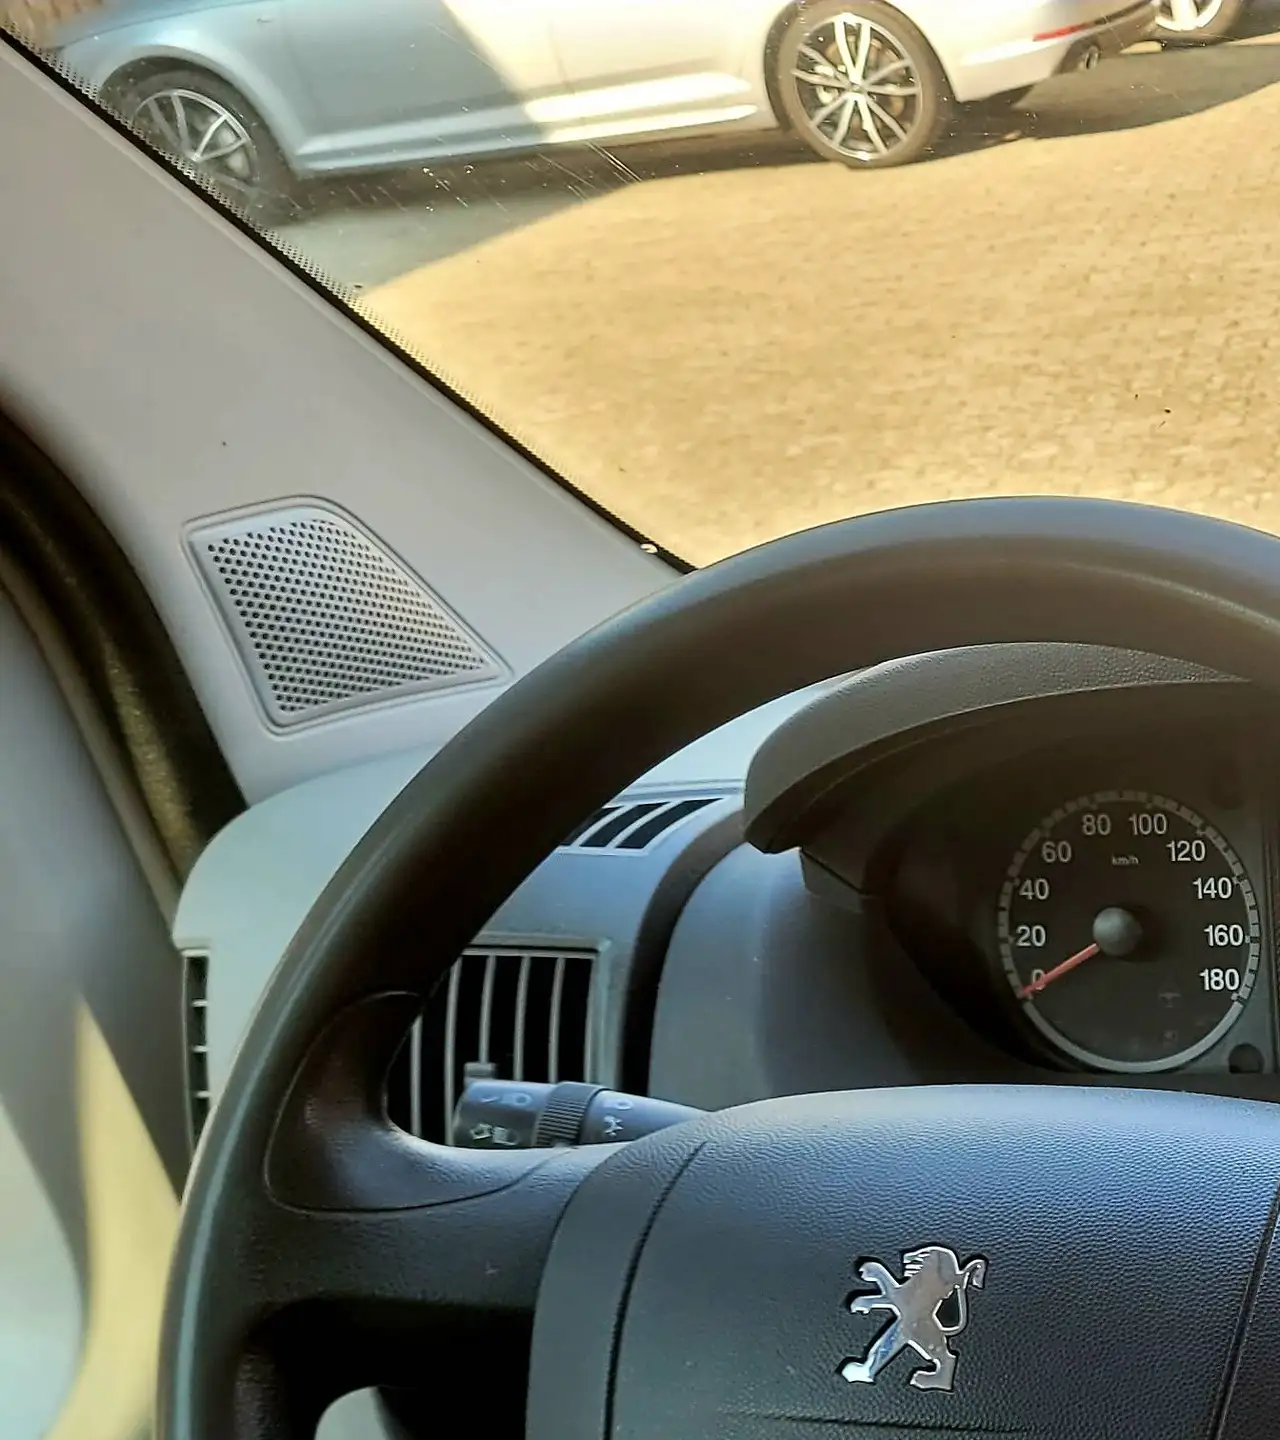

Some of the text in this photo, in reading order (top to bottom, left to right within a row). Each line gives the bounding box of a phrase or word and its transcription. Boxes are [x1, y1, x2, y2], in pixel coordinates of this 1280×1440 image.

[1082, 814, 1111, 836] 80
[1128, 813, 1167, 836] 100
[1042, 841, 1073, 863] 60
[1166, 840, 1206, 862] 120
[1019, 878, 1050, 900] 40
[1192, 877, 1232, 900] 140
[1016, 925, 1046, 948] 20
[1204, 925, 1244, 947] 160
[1200, 968, 1240, 991] 180
